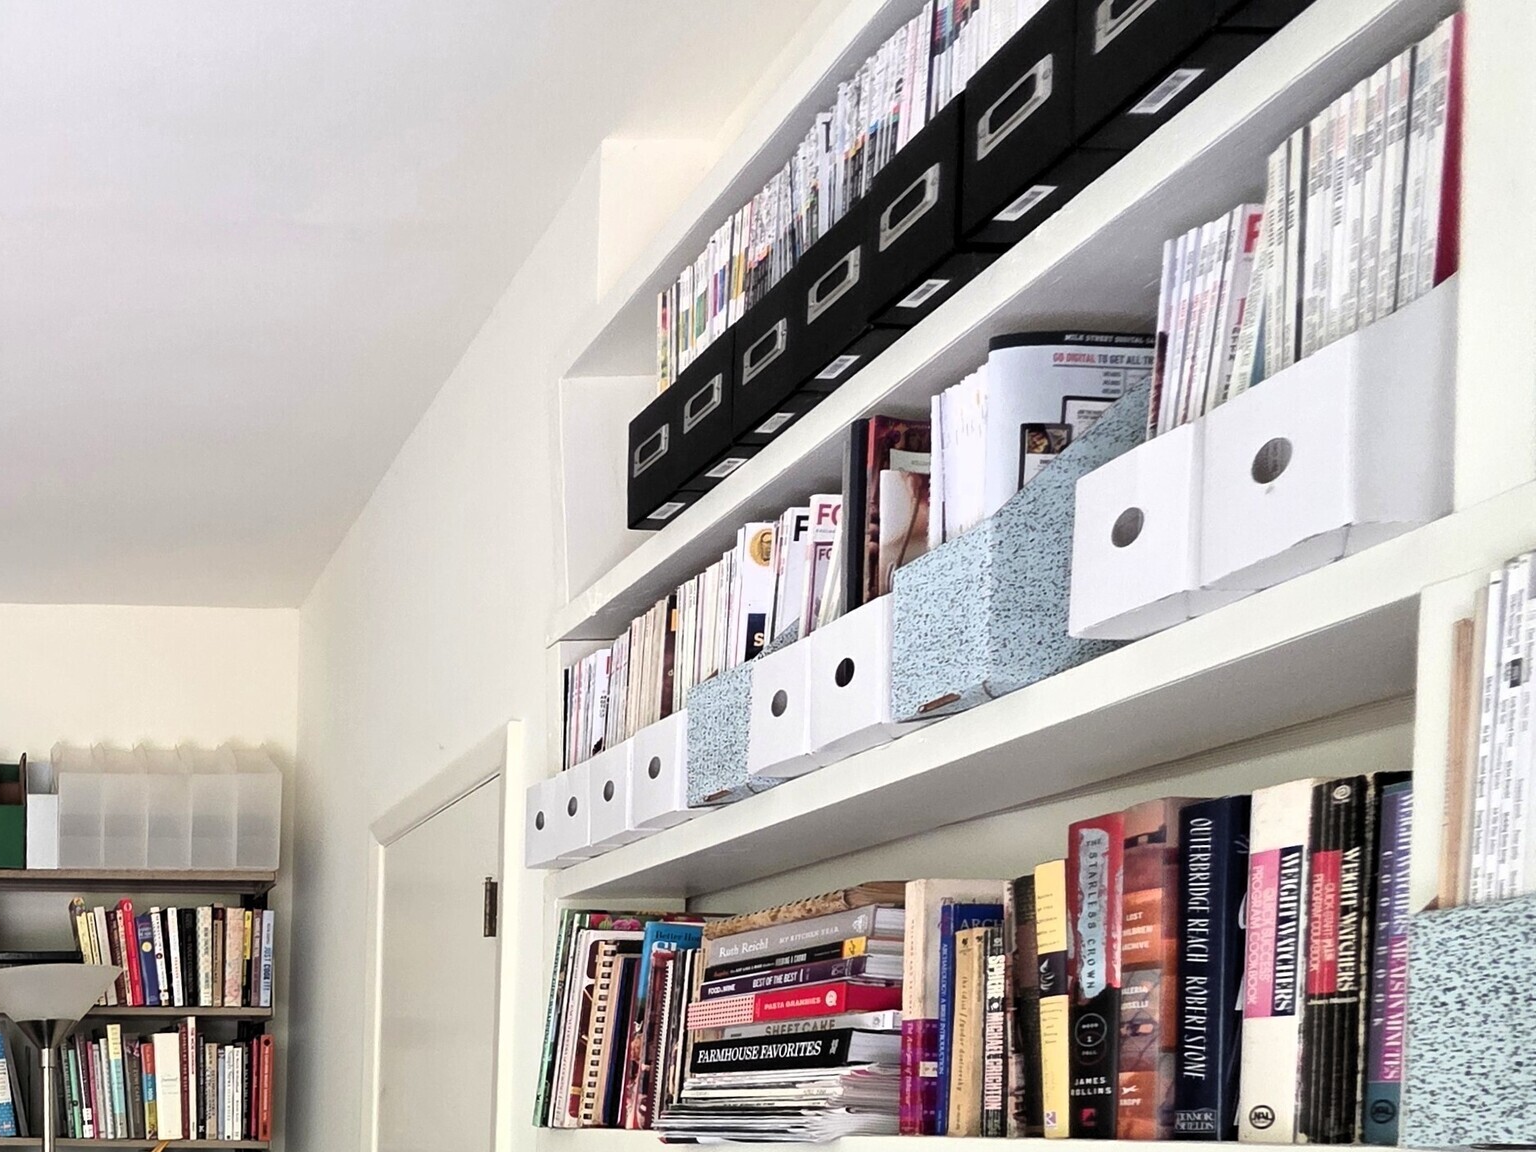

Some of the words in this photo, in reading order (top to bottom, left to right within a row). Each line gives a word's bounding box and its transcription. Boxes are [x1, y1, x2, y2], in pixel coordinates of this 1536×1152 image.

[1053, 353, 1064, 362] GO
[1066, 353, 1096, 363] DIGITAL
[1098, 354, 1108, 363] TO
[1110, 355, 1124, 364] GET
[1126, 355, 1141, 364] ALL
[1088, 851, 1098, 930] STARLESS
[1187, 818, 1212, 914] OUTERBRIDGE
[1279, 852, 1300, 919] WEIGHT
[1341, 846, 1360, 908] WEIGHT
[1126, 911, 1143, 920] LOST
[1250, 865, 1263, 929] PROGRAM
[1264, 888, 1275, 923] QUICK
[719, 946, 739, 958] Ruth
[742, 938, 769, 953] Reichl
[1087, 936, 1097, 990] CROWN
[1186, 918, 1209, 963] REACH
[1260, 927, 1273, 982] SUCCESS
[1388, 938, 1407, 992] MEALS
[752, 976, 765, 988] BEST
[766, 975, 773, 986] OF
[773, 974, 783, 985] THE
[783, 971, 798, 983] BEST
[987, 954, 1006, 999] SPHERE
[1247, 931, 1260, 1006] COOKBOOK
[764, 1001, 785, 1010] PASTA
[786, 997, 821, 1008] GRANNIES
[1184, 976, 1208, 1033] ROBERT
[697, 1046, 759, 1064] FARMHOUSE
[760, 1040, 822, 1058] FAVORITES
[938, 1023, 946, 1074] INTRODUCTION
[986, 1011, 1004, 1055] MICHAEL
[1183, 1034, 1206, 1080] STONE
[1383, 1012, 1401, 1080] MINUTES
[985, 1059, 1003, 1110] CRICHTON
[1074, 1078, 1106, 1086] JAMES
